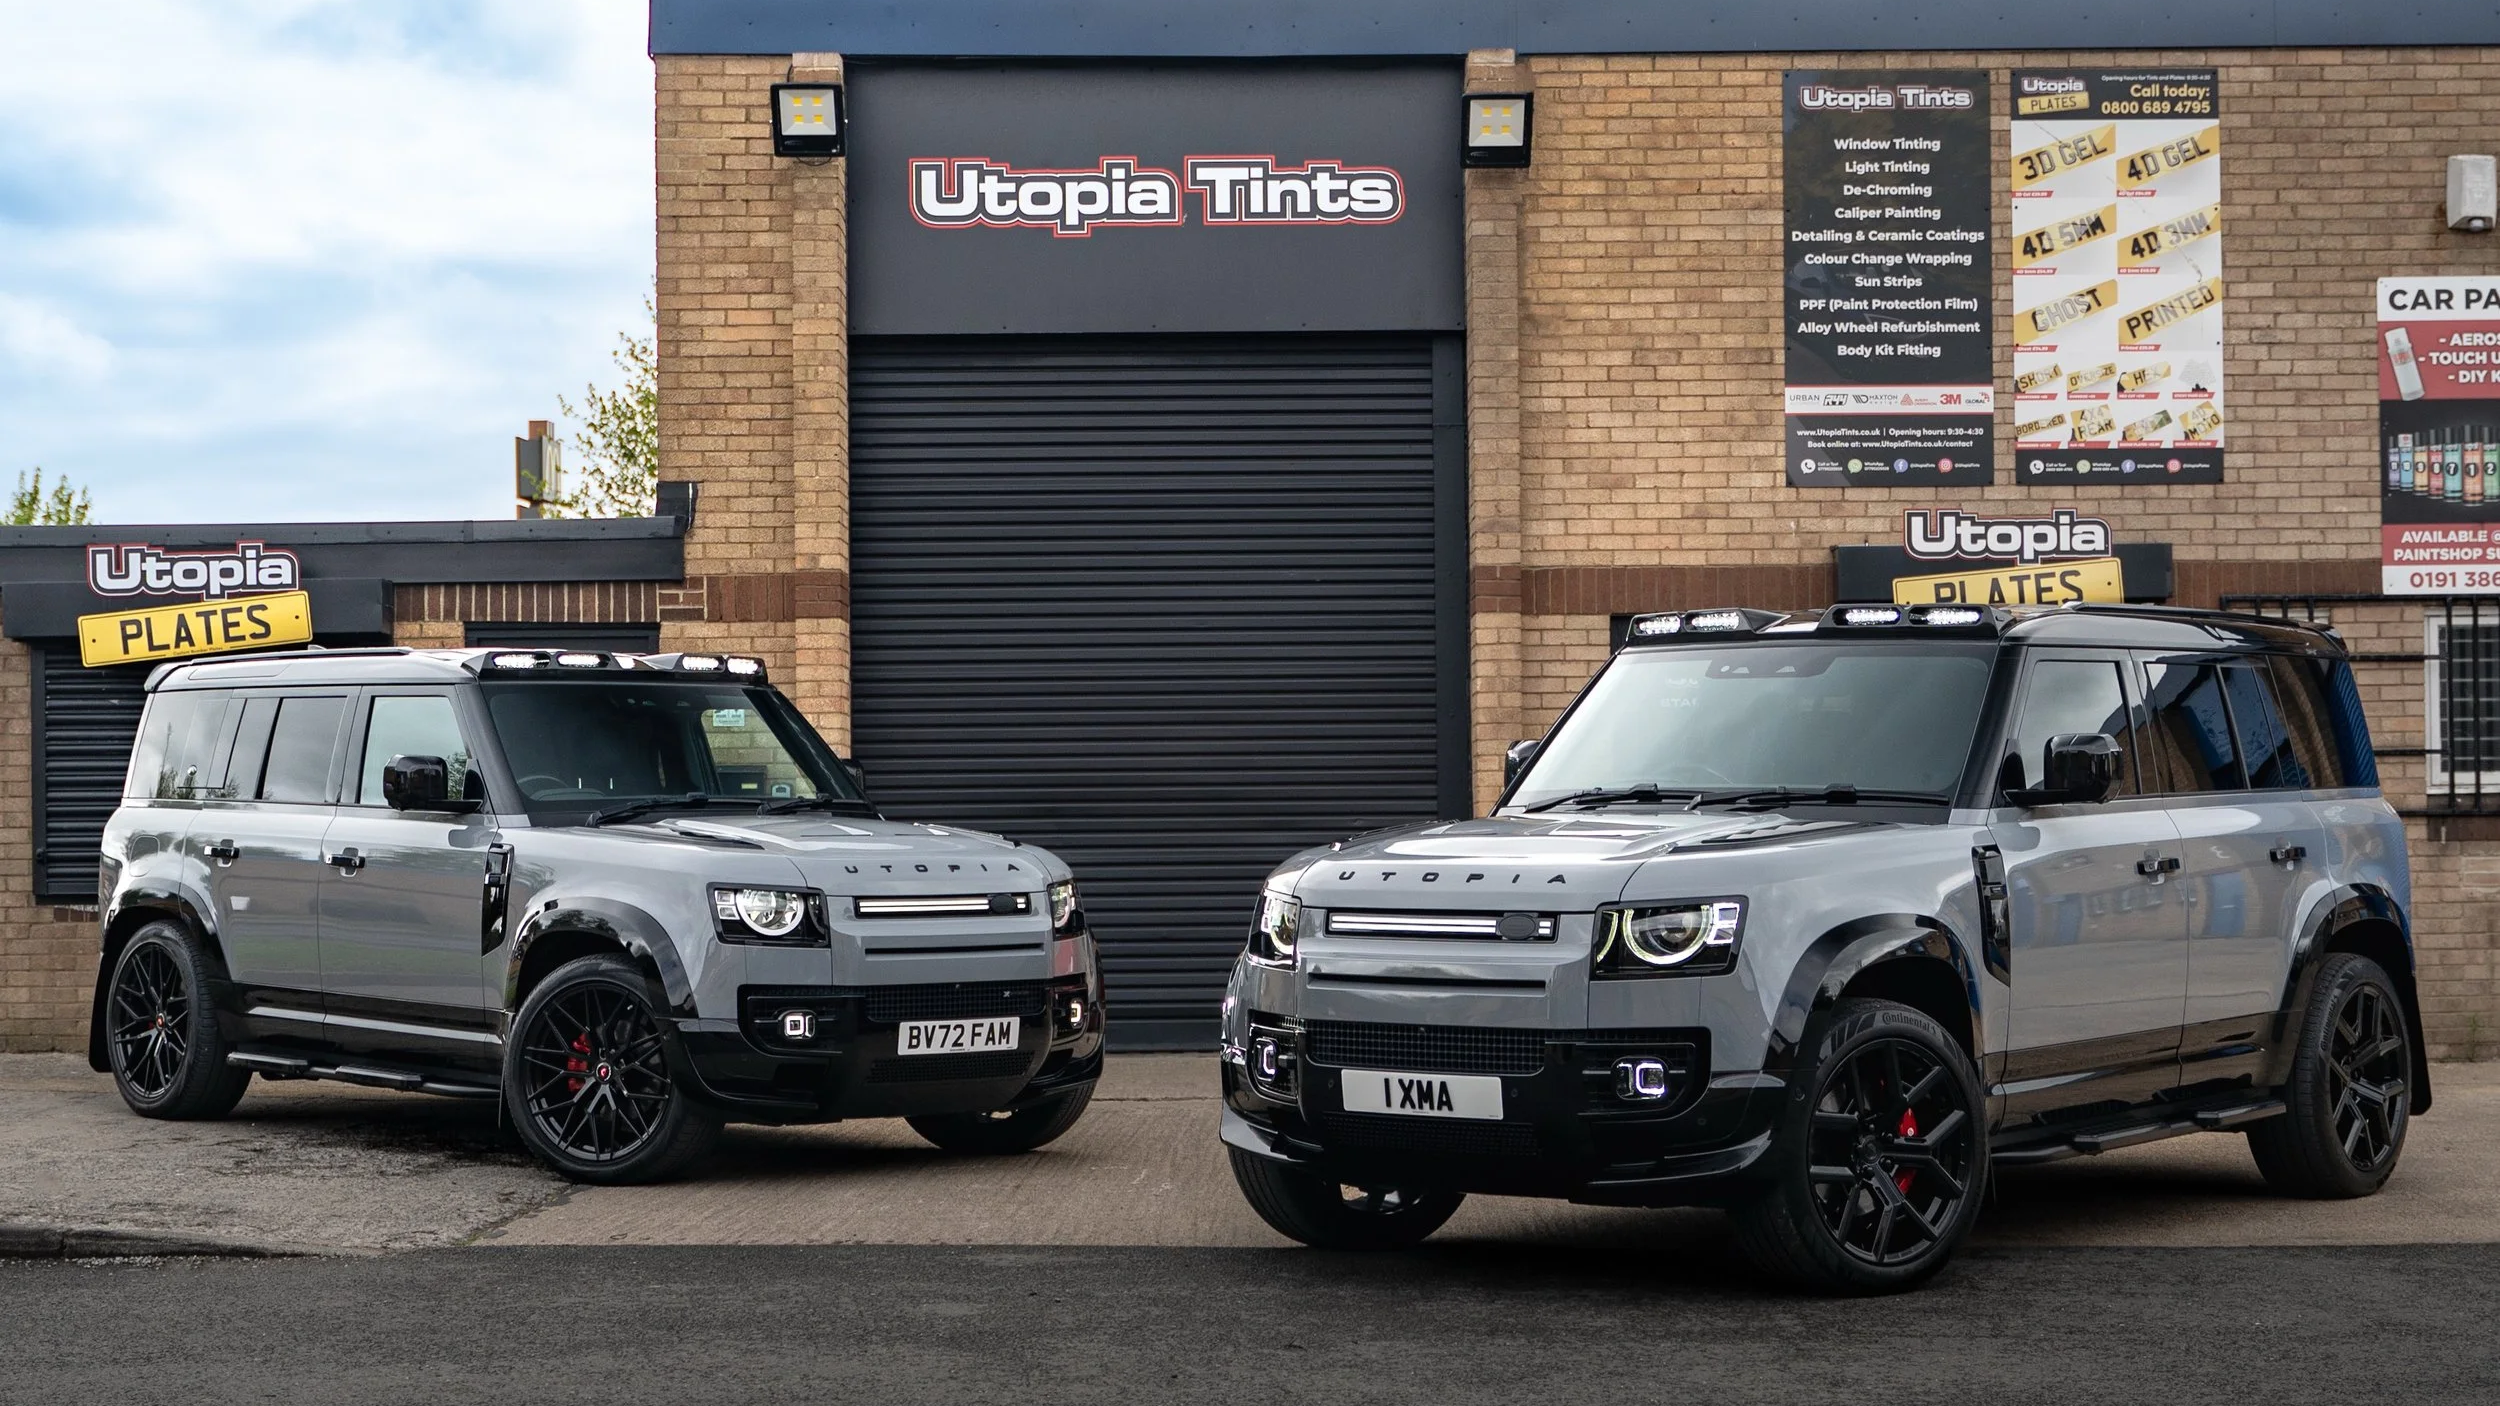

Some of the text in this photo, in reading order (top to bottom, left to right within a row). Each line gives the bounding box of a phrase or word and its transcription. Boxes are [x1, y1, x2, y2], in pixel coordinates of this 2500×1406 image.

[2022, 78, 2084, 93] Utopia
[2130, 83, 2210, 100] Call today:
[1802, 87, 1972, 111] Utopia Tints
[2030, 96, 2077, 111] PLATES
[2101, 101, 2211, 114] 0800 689 4795
[1834, 137, 1941, 151] Window Tinting
[2019, 134, 2108, 180] 3D GEL
[2127, 136, 2210, 181] 4D GEL
[1845, 161, 1930, 174] Light Tinting
[915, 161, 1398, 231] Utopia Tints
[1843, 184, 1932, 197] De-Chroming
[1834, 207, 1941, 220] Caliper Painting
[1791, 229, 1985, 243] Detailing & Ceramic Coatings
[2022, 213, 2106, 259] 4D 5MM
[2131, 212, 2211, 258] 4D 3MM
[1804, 252, 1972, 266] Colour Change Wrapping
[1855, 276, 1923, 289] Sun Strips
[1799, 298, 1978, 312] PPF (Paint Protection Film)
[2389, 289, 2454, 311] CAR
[2031, 288, 2103, 332] GHOST
[2125, 284, 2215, 339] PRINTED
[1797, 321, 1981, 335] Alloy Wheel Refurbishment
[2450, 333, 2500, 346] AERO
[1837, 345, 1941, 358] Body Kit Fitting
[2429, 352, 2487, 364] TOUCH
[2459, 370, 2488, 383] DIY
[1789, 394, 1820, 402] URBAN
[1940, 393, 1962, 405] 3M
[1796, 428, 1881, 437] www.UtopiaTints.co.uk
[1888, 428, 1922, 437] Opening
[1923, 428, 1947, 436] hours:
[1862, 441, 1974, 449] www.UtopiaTints.co.uk/contact
[2448, 463, 2456, 475] 7
[2468, 464, 2475, 477] 1
[2487, 463, 2495, 475] 2
[1907, 511, 2108, 562] Utopia
[2401, 530, 2488, 543] AVAILABLE
[2393, 548, 2483, 561] PAINTSHOP
[92, 545, 295, 597] Utopia
[2410, 571, 2457, 588] 0191
[119, 603, 272, 655] PLATES
[844, 863, 1020, 874] UTOPIA
[1338, 871, 1567, 884] UTOPIA
[907, 1021, 1012, 1050] BV72 FAM
[1398, 1078, 1454, 1112] XMA
